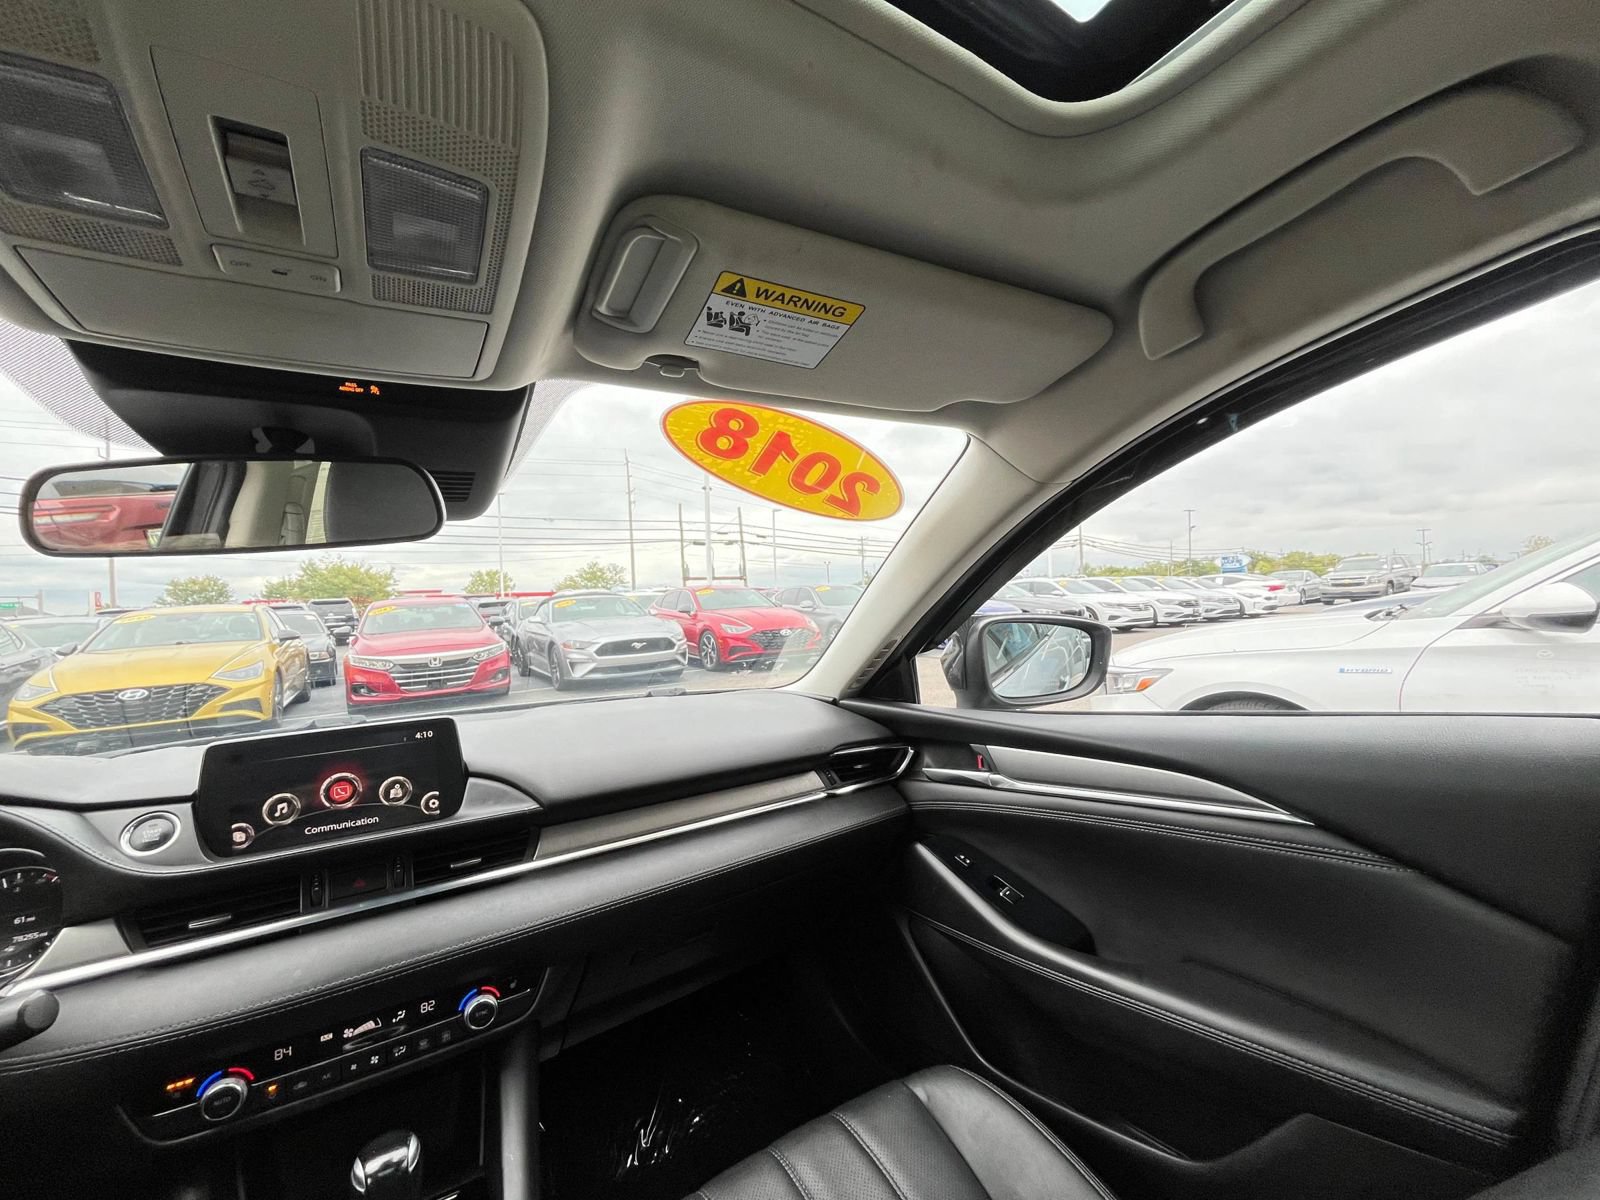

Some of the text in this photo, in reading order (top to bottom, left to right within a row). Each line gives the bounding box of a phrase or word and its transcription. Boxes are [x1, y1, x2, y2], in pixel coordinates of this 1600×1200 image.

[755, 286, 847, 318] WARNING
[725, 300, 745, 309] EVEN
[748, 305, 766, 314] WITH
[769, 311, 806, 323] ADVANCED
[415, 730, 434, 740] 4:10
[304, 815, 379, 835] Communication
[420, 1000, 436, 1014] 82
[274, 1046, 292, 1062] 84
